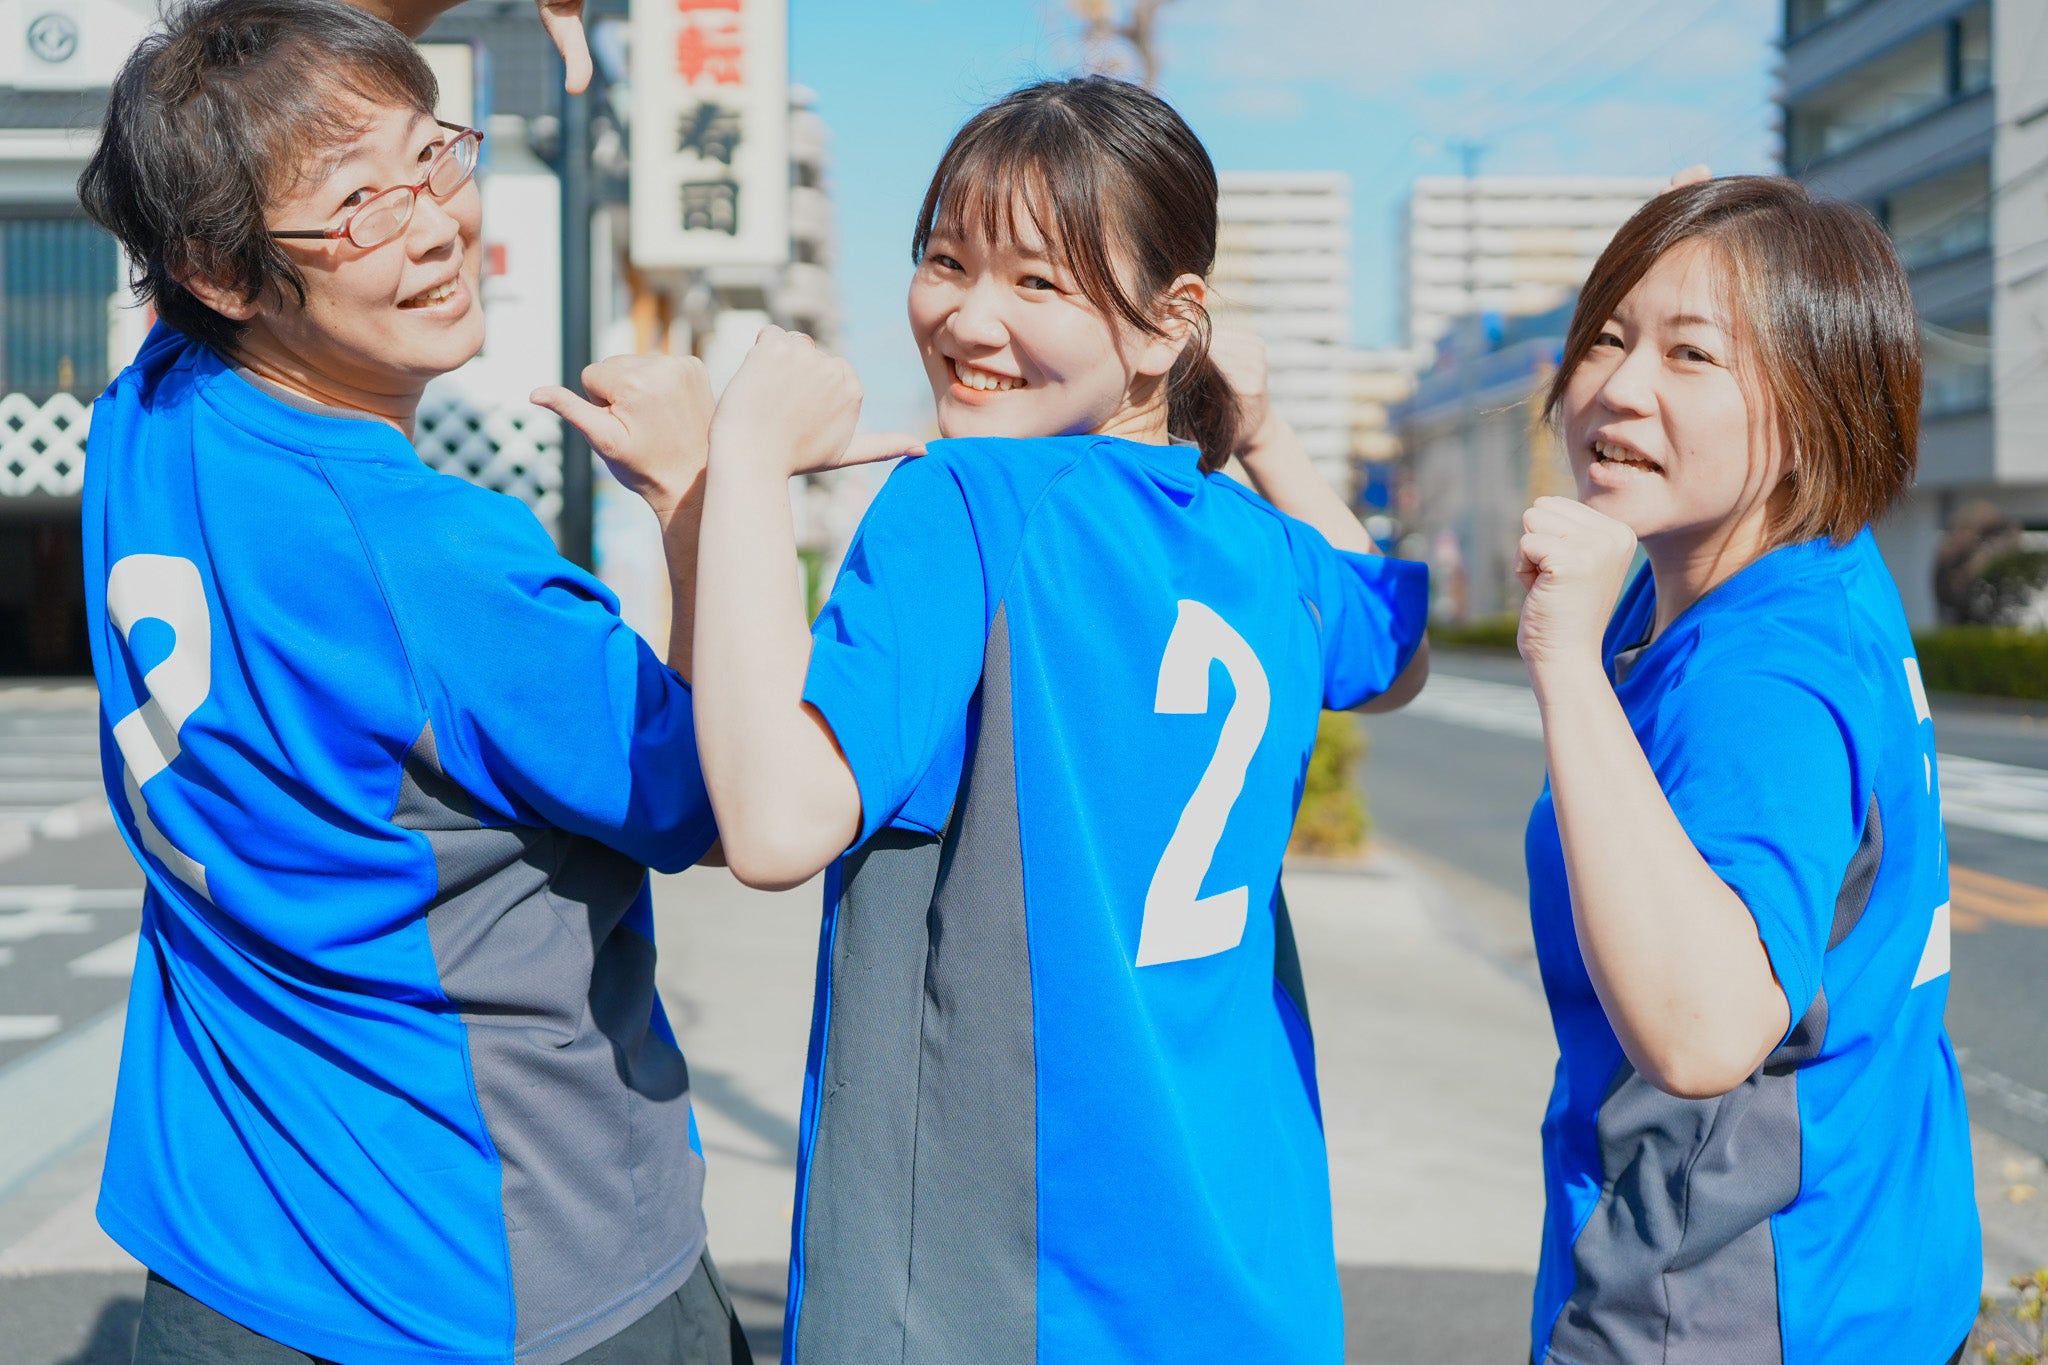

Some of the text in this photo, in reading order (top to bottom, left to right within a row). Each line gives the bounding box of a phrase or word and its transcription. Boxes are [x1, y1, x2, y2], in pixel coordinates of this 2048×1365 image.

[676, 0, 742, 236] 転寿司
[1136, 600, 1271, 967] 2
